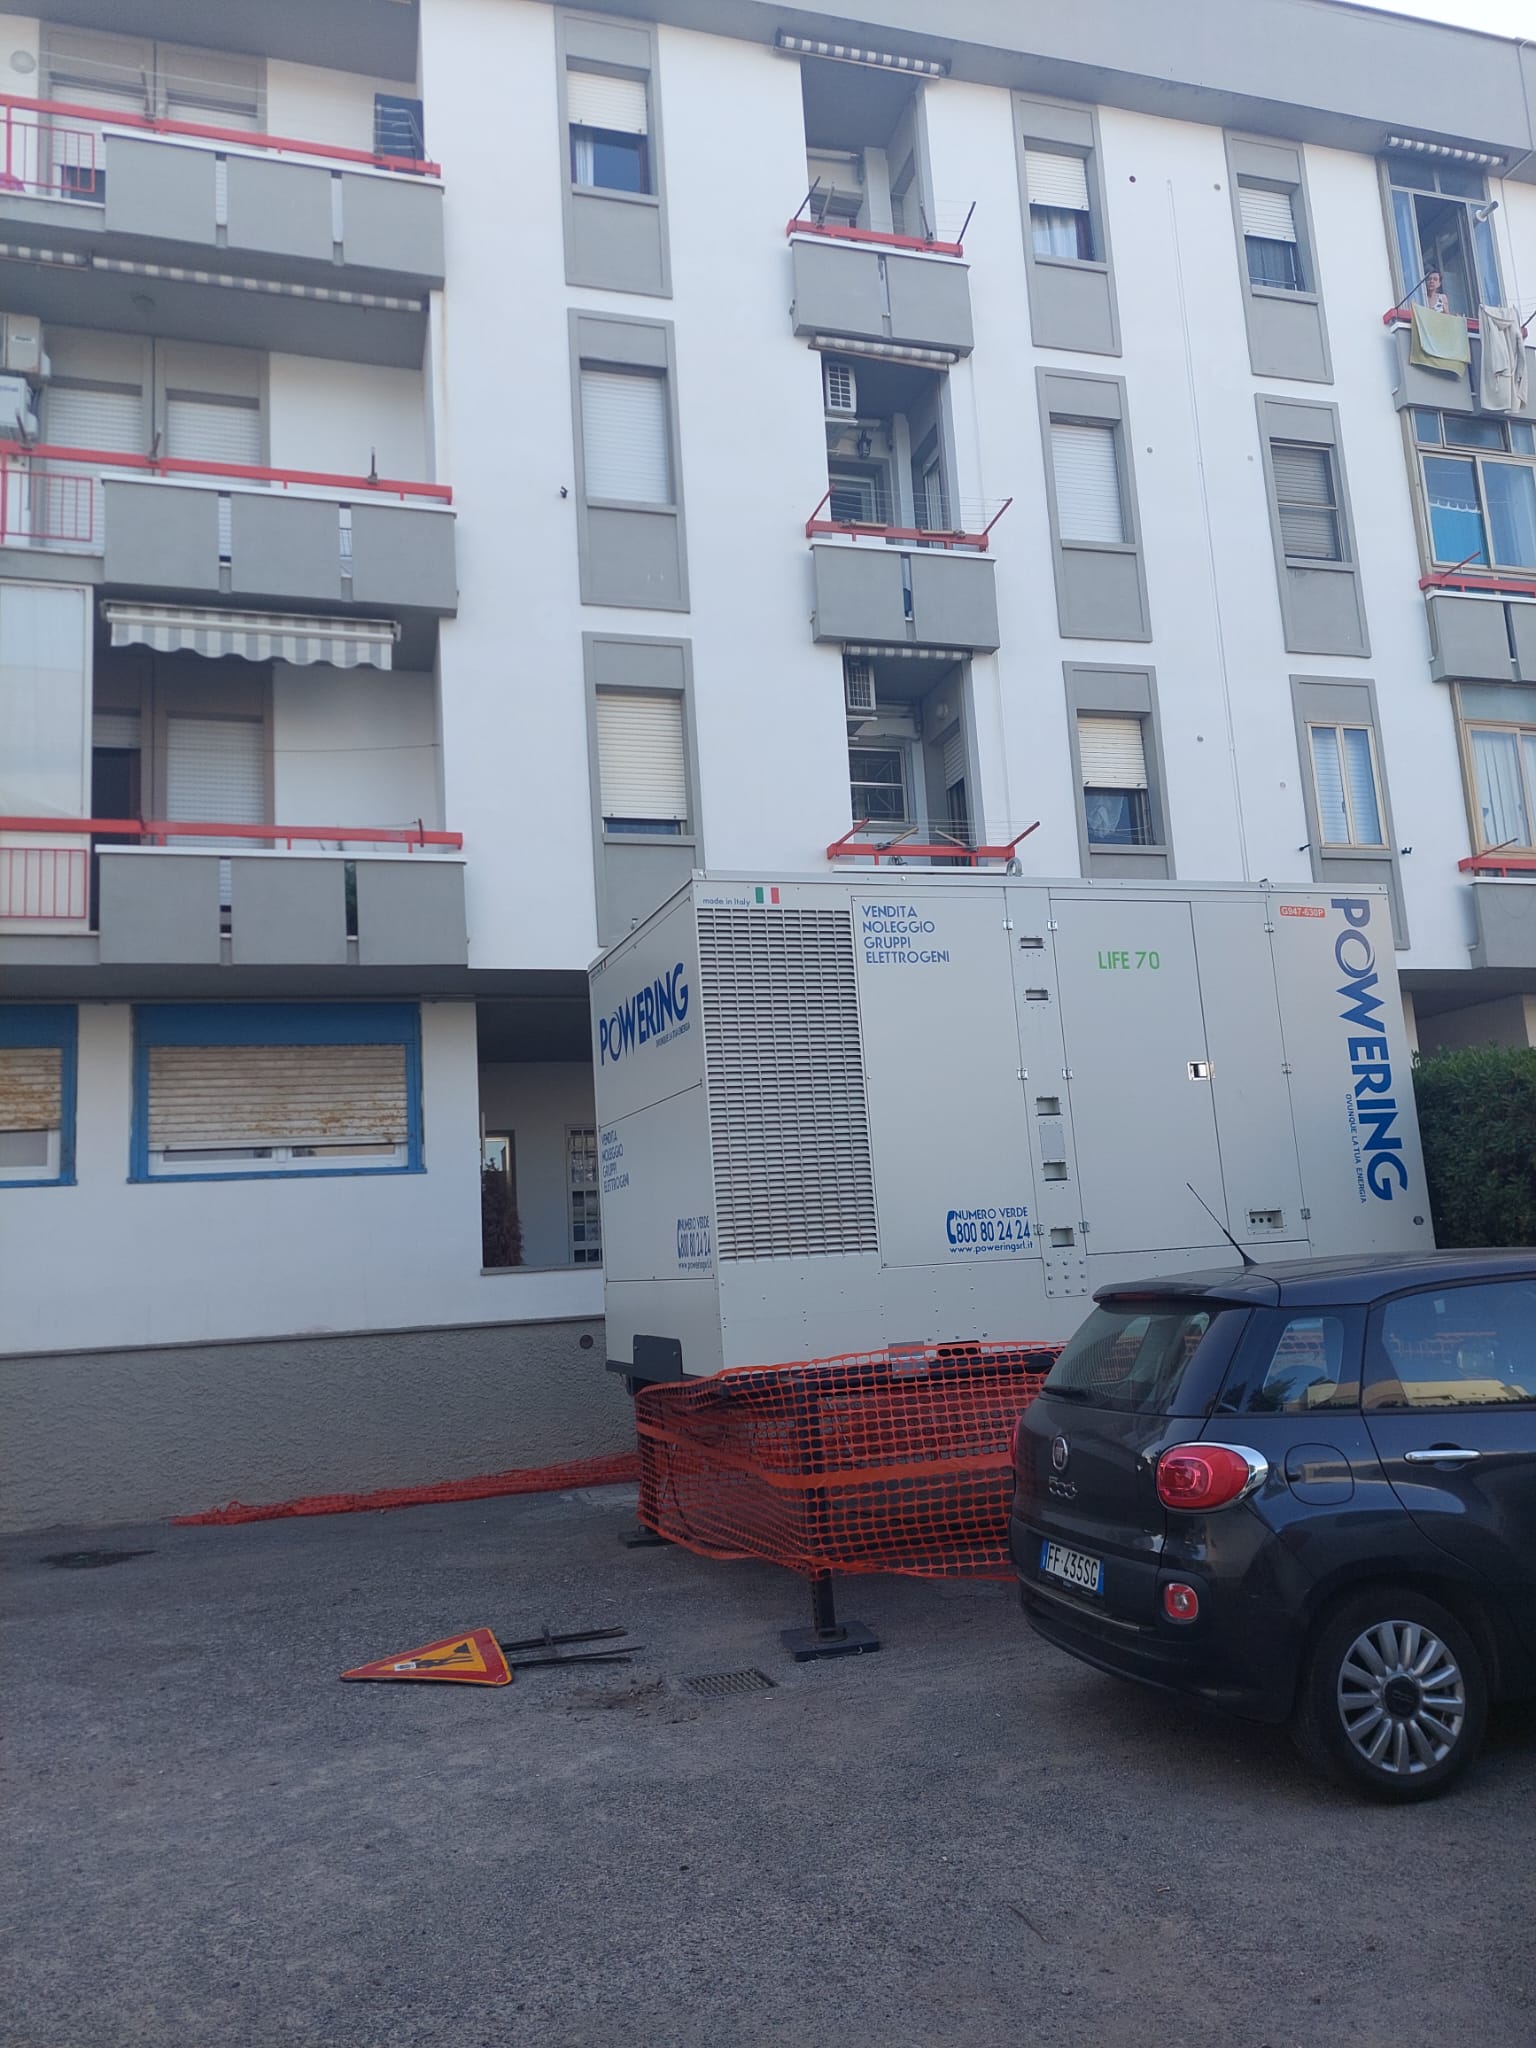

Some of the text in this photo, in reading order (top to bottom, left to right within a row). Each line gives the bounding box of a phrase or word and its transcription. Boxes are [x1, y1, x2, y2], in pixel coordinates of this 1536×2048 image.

[702, 897, 751, 908] made in Italy
[862, 905, 918, 918] VENDITA
[863, 921, 936, 934] NOLEGGIO
[864, 936, 911, 949] GRUPPI
[866, 950, 950, 964] ELETTROGENI
[1098, 951, 1160, 970] LIFE 70
[599, 962, 689, 1067] POWERING
[1331, 898, 1408, 1201] POWERING
[1345, 1093, 1367, 1204] OVUNQUE LA TUA ENERGIA
[953, 1206, 1028, 1221] NUMERO VERDE
[956, 1219, 1031, 1243] 800 80 24 24
[949, 1241, 1033, 1255] www.poweringsrl.it
